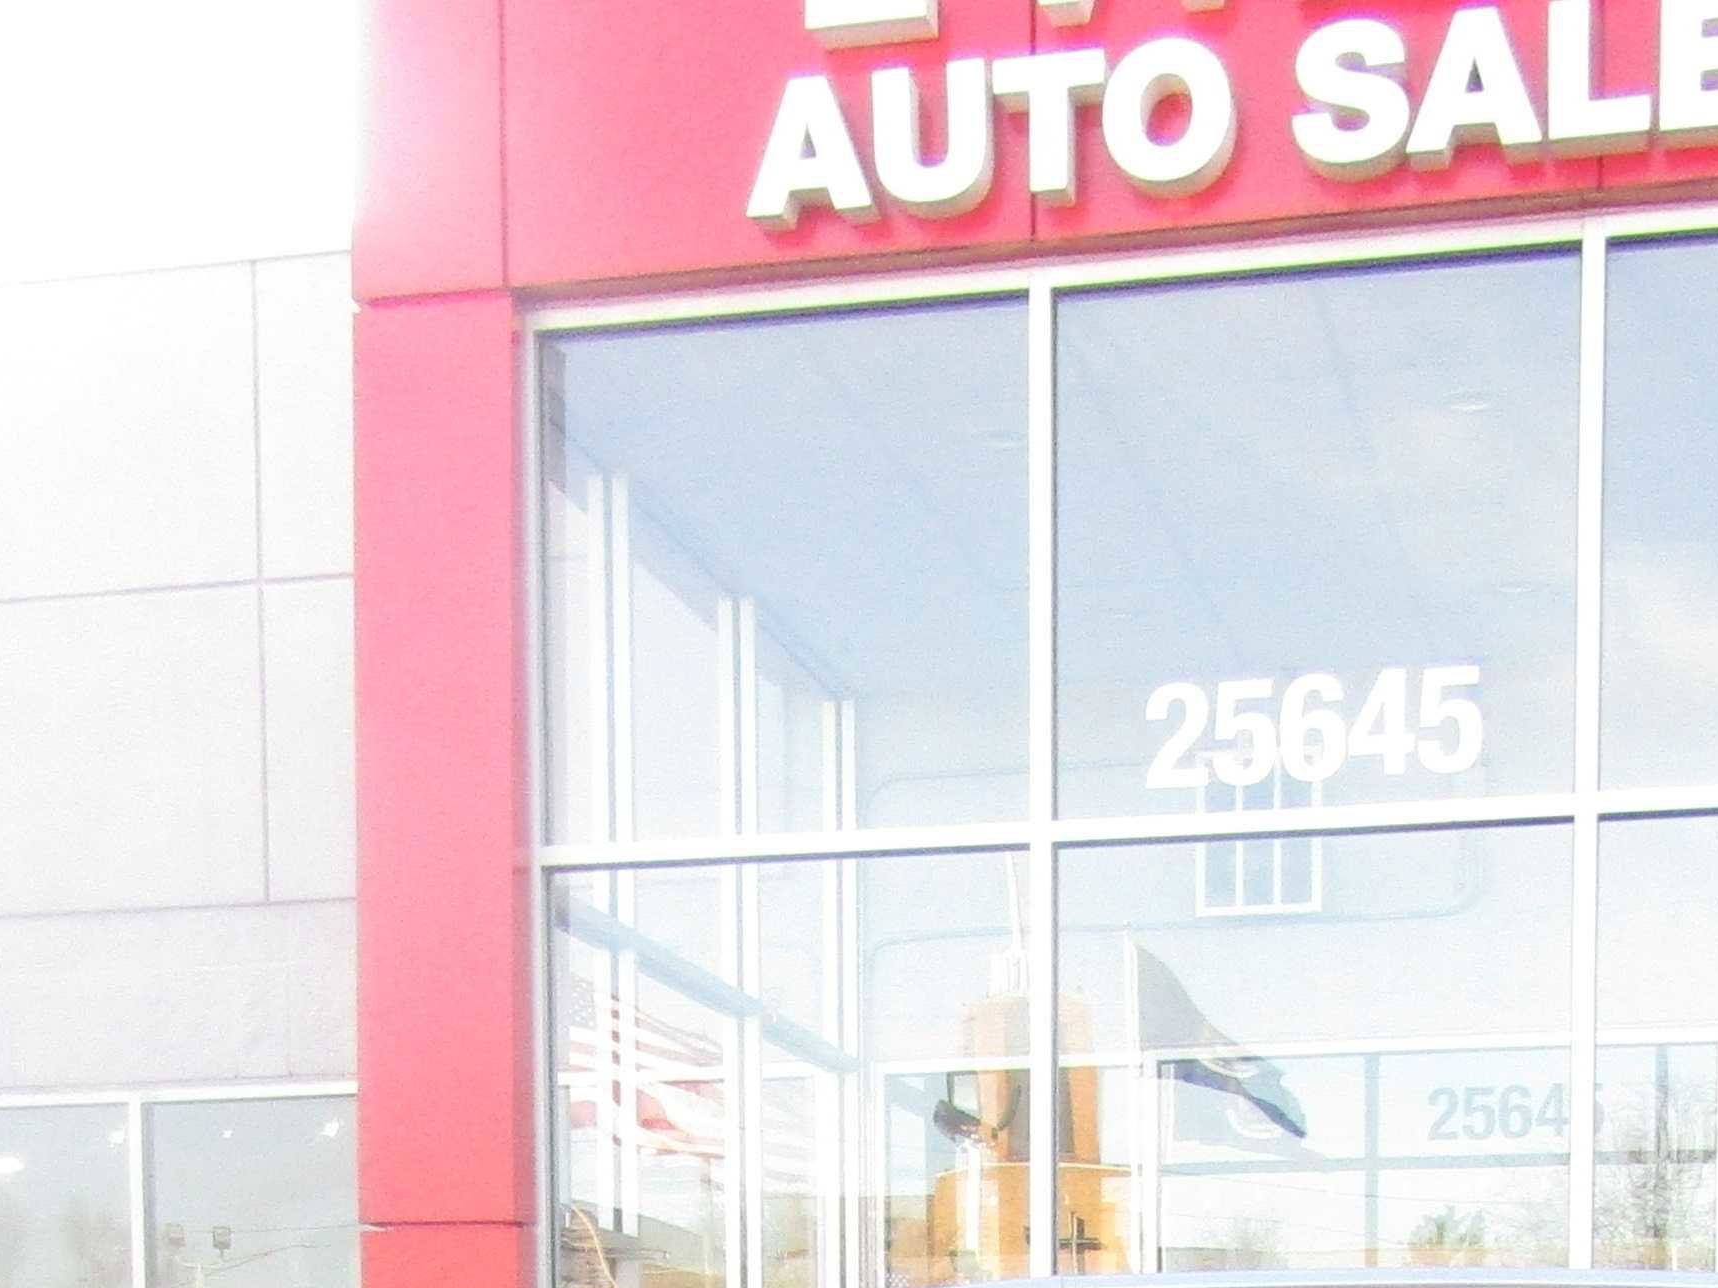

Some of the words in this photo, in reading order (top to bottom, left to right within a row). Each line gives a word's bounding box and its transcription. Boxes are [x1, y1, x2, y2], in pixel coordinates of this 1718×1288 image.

[746, 37, 1235, 230] AUTO
[1145, 666, 1484, 789] 25645
[1427, 1082, 1605, 1141] 2564
